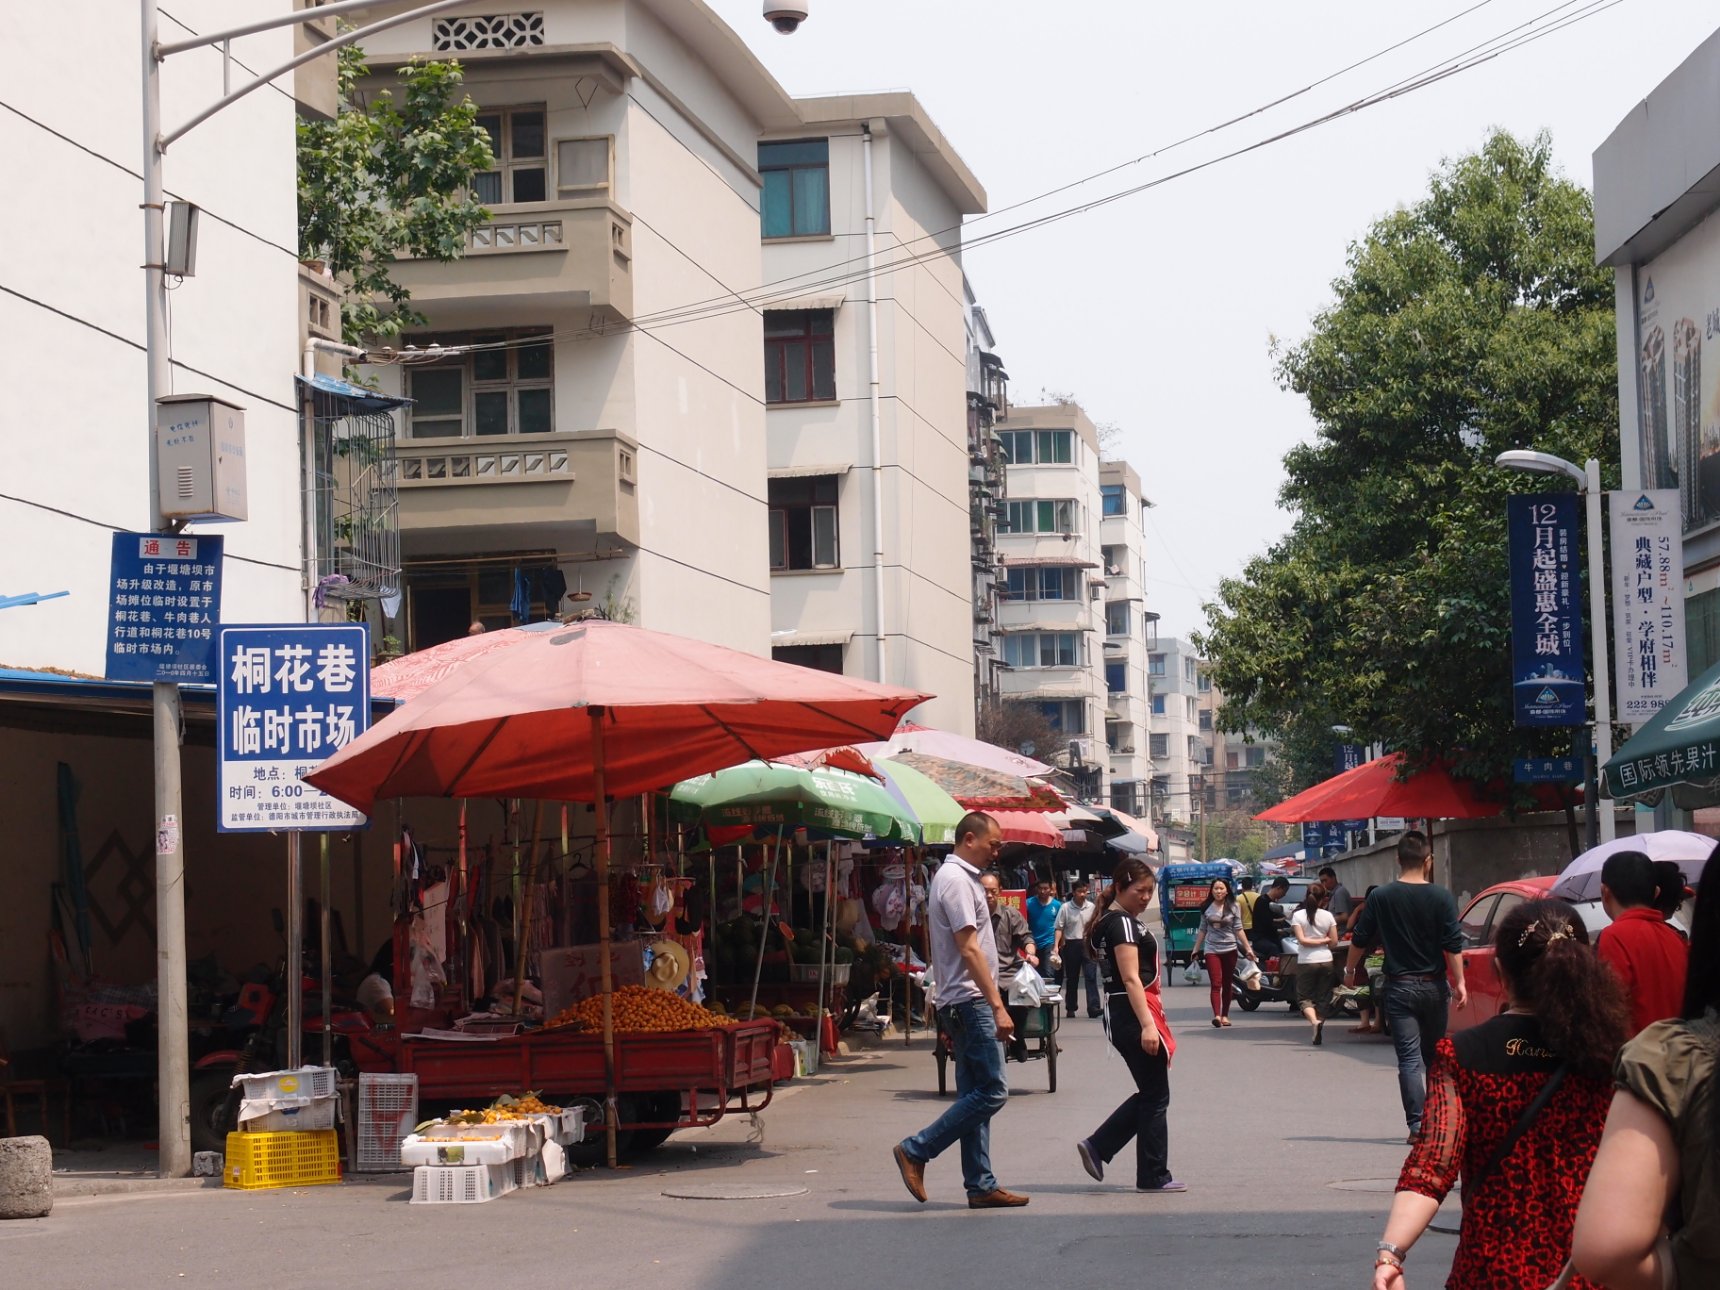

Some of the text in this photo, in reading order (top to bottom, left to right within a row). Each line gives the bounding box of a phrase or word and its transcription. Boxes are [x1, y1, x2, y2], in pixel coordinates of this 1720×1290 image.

[144, 540, 191, 556] 通告
[144, 563, 215, 576] 由于堰塘坝市
[116, 579, 213, 592] 场升级改造，原市
[1528, 503, 1560, 656] 12月起盛惠全城
[116, 595, 213, 607] 场摊位临时设置于
[115, 611, 212, 623] 桐花巷、牛肉巷人
[1635, 536, 1657, 688] 典藏户型·学府相伴
[114, 627, 212, 639] 行道和桐花巷10号
[113, 643, 180, 655] 临时市场内。
[231, 644, 356, 694] 桐花巷
[1626, 700, 1647, 709] 222
[232, 704, 355, 755] 临时市场
[1524, 762, 1573, 772] 牛肉巷
[1620, 743, 1717, 788] 国际领先果汁
